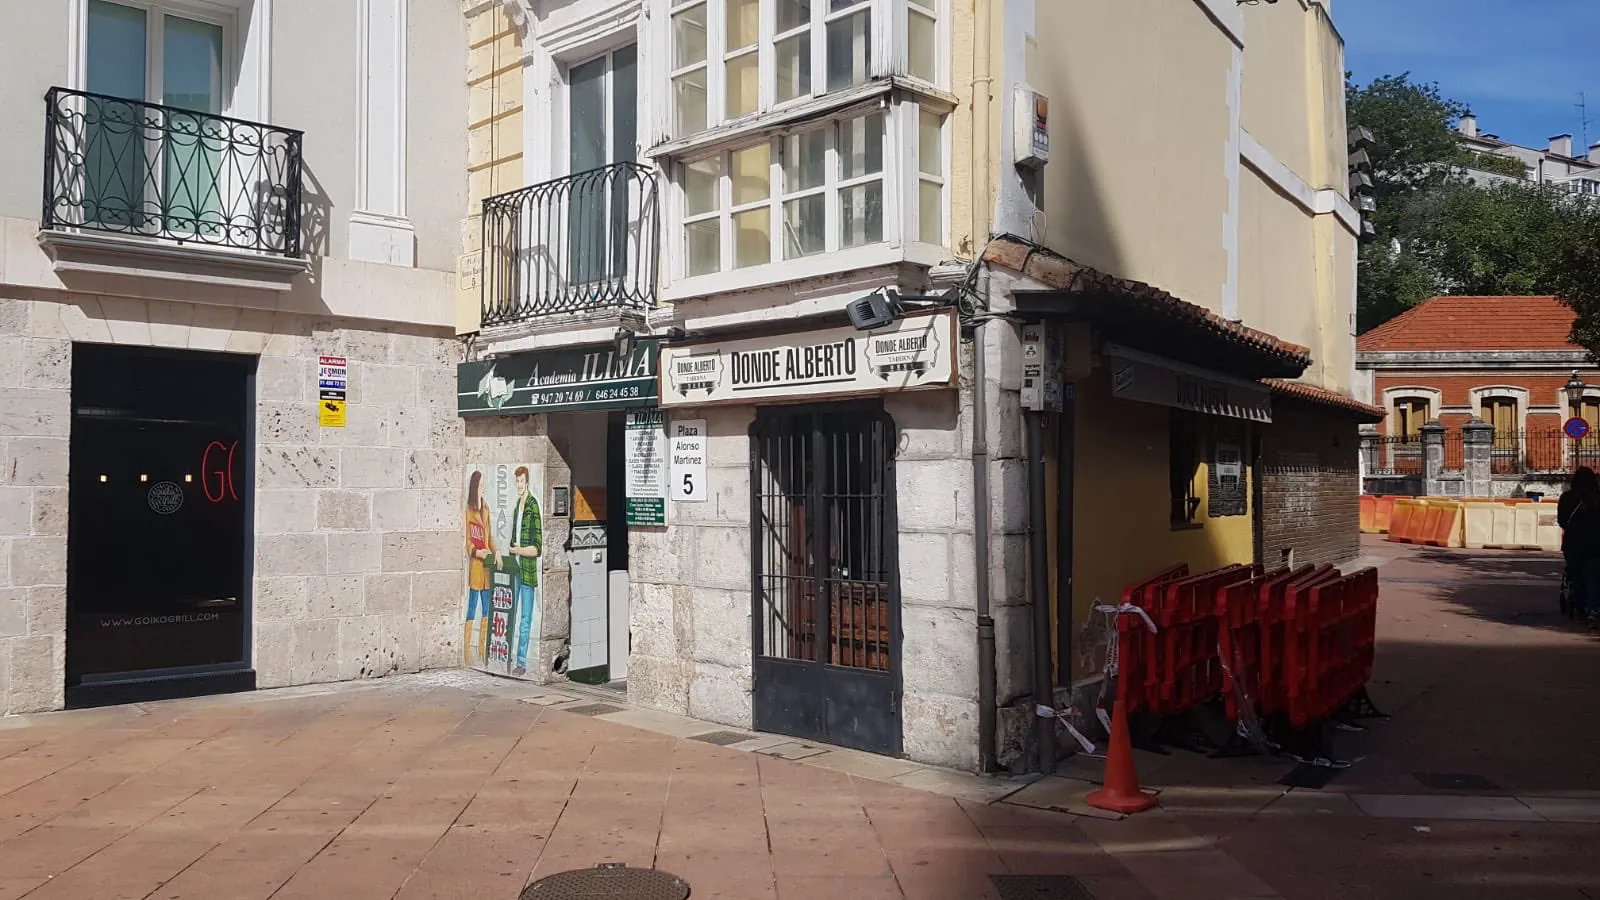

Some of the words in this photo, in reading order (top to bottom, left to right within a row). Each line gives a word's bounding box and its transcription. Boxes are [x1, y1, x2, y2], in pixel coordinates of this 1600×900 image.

[875, 339, 897, 354] DONDE
[898, 334, 928, 352] ALBERTO
[526, 361, 577, 387] Academia
[580, 346, 651, 382] ILIMA
[694, 358, 716, 372] ALBERTO
[731, 350, 781, 385] DONDE
[785, 337, 856, 381] ALBERTO
[319, 368, 346, 378] JESMON
[541, 392, 554, 404] 947
[555, 392, 563, 402] 20
[565, 391, 574, 402] 74
[574, 390, 584, 402] 69
[596, 388, 608, 400] 646
[610, 388, 618, 399] 24
[620, 388, 628, 398] 45
[630, 386, 639, 397] 38
[636, 413, 662, 424] ILIMA
[678, 425, 698, 436] Plaza
[676, 440, 700, 451] Alonso
[683, 474, 694, 495] 5
[496, 464, 508, 540] SPEAK
[100, 612, 220, 628] WWW.GOIKOGRILL.COM
